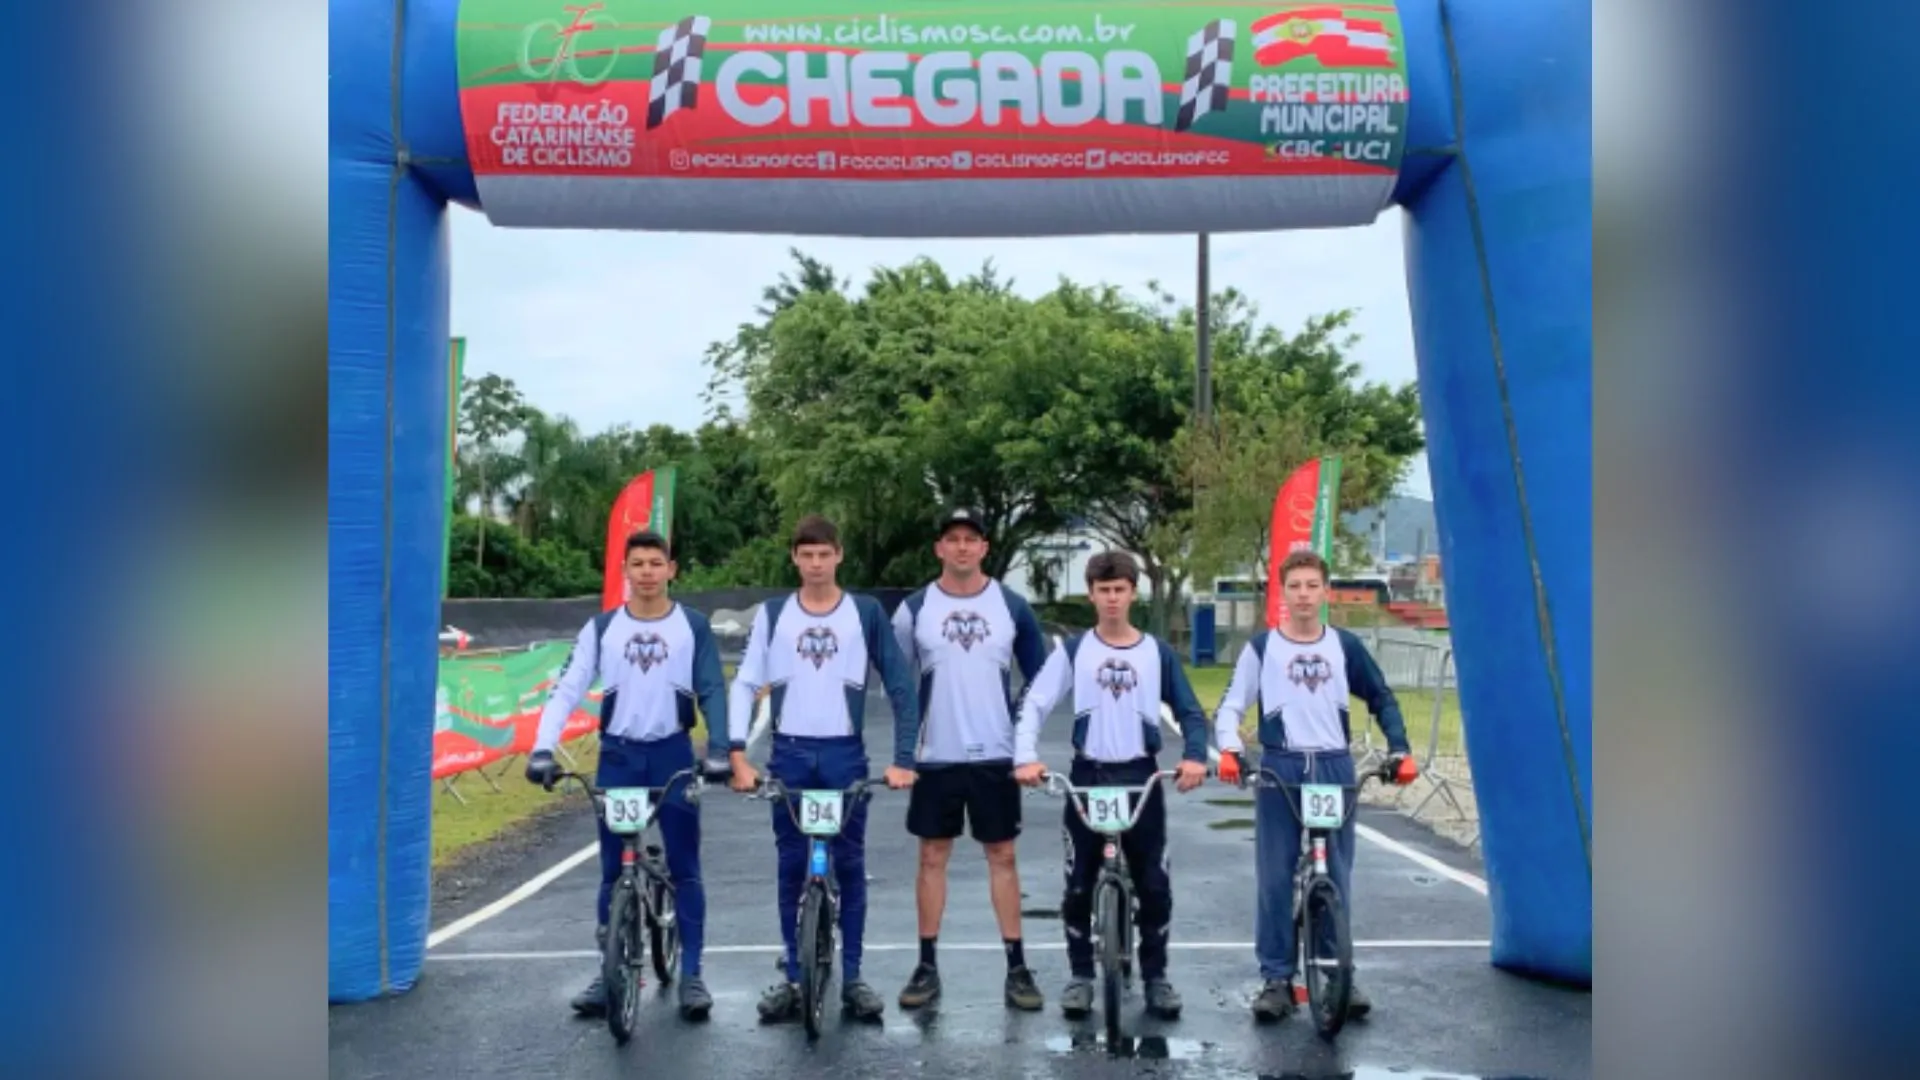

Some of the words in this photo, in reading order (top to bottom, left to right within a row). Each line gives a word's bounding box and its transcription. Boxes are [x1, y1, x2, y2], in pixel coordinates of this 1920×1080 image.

[743, 14, 1136, 45] www.ciclismosc.com.br
[716, 50, 1163, 126] CHEGADA
[1250, 73, 1405, 103] PREFEITURA
[497, 99, 629, 126] FEDERAÇÃO
[1260, 104, 1398, 134] MUNICIPAL
[490, 126, 635, 147] CATARINENSE
[502, 148, 528, 165] DE
[532, 148, 632, 167] CICLISMO
[1279, 140, 1326, 158] CBC
[1343, 142, 1391, 160] UCI
[613, 799, 640, 822] 93
[808, 800, 834, 824] 94
[1096, 798, 1119, 822] 91
[1309, 793, 1337, 817] 92
